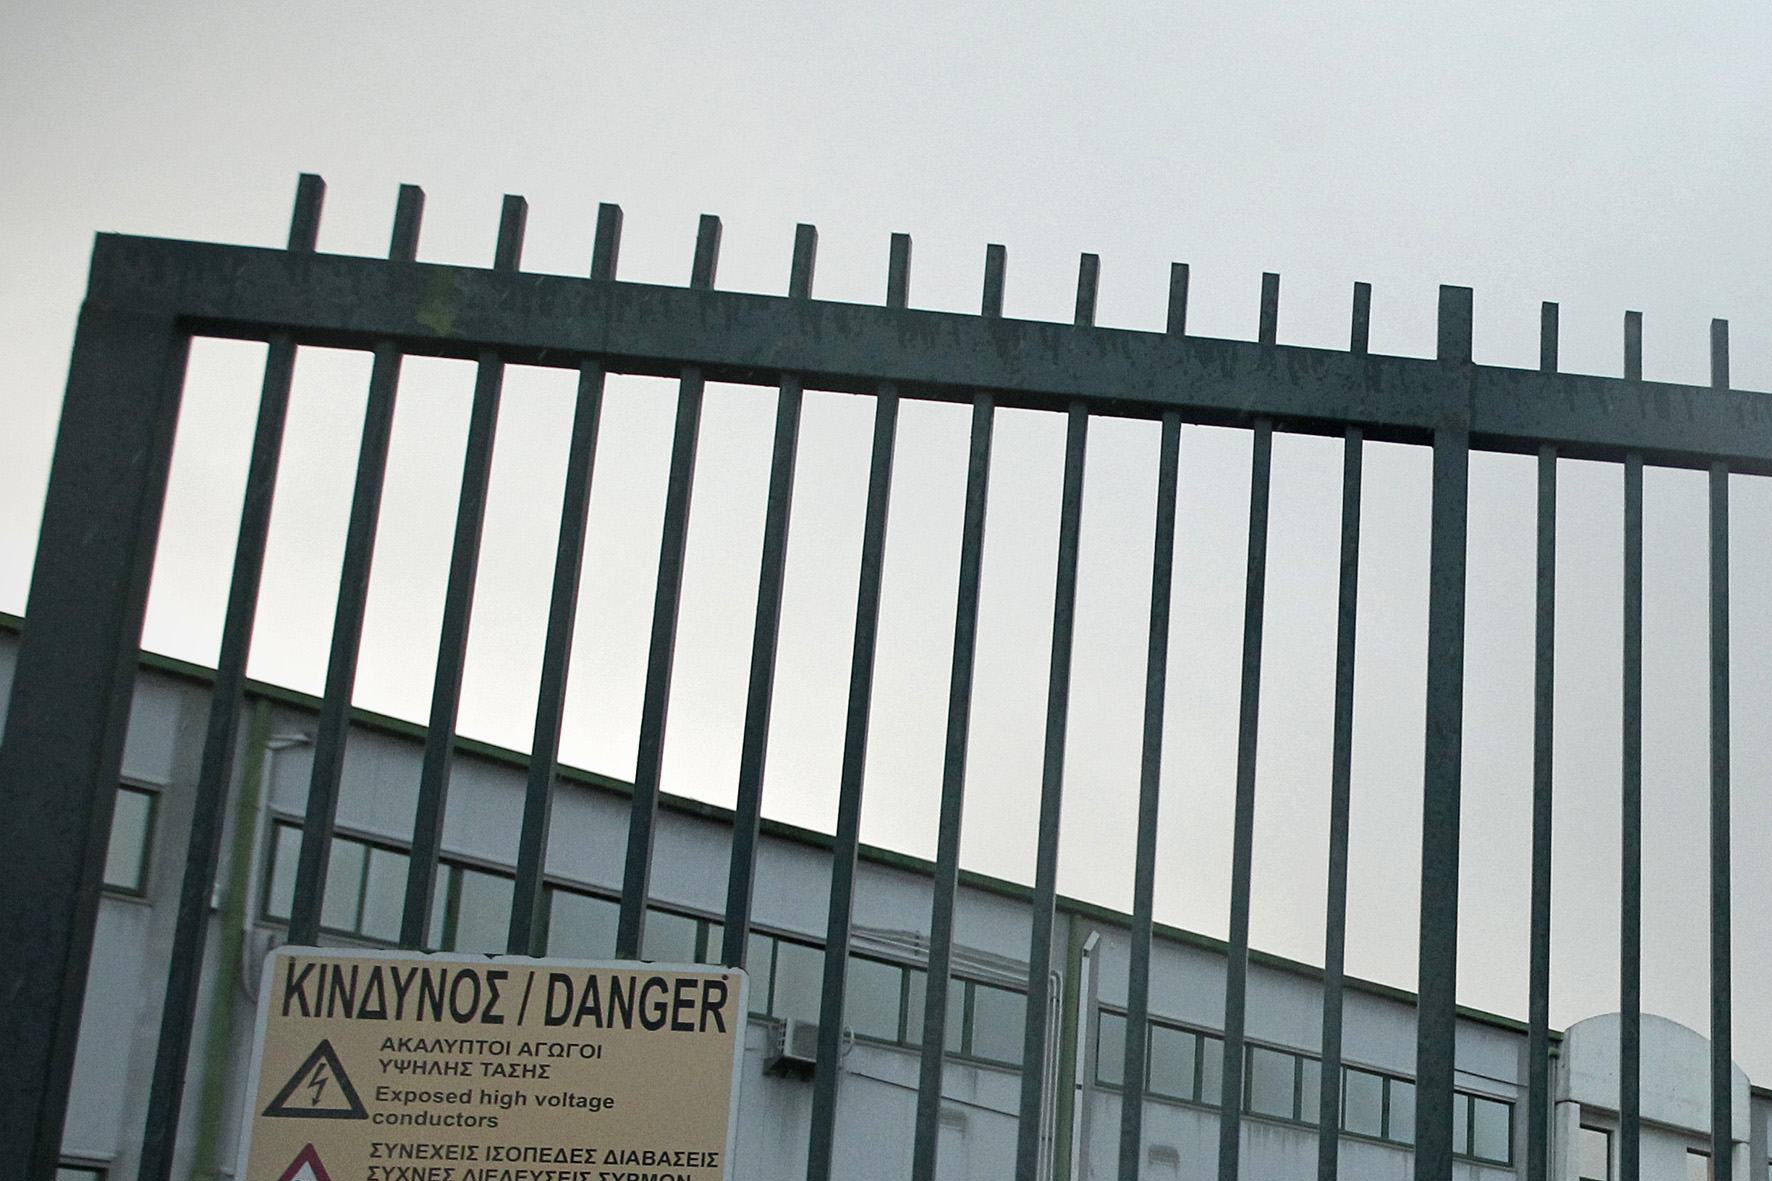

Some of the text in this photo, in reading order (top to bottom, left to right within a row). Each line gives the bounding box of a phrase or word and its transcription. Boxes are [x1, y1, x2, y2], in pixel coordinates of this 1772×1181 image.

[281, 961, 729, 1033] ΚΙΝΔΥΝΟΣ / DANGER
[380, 1037, 602, 1059] ΑΚΑΛΥΠΤΟΙ ΑΓΩΓΟΙ
[379, 1059, 551, 1080] ΥΨΗΛΗΣ ΤΑΣΗΣ
[375, 1086, 615, 1112] Exposed high voltage
[372, 1110, 499, 1129] conductors
[369, 1142, 719, 1168] ΣΥΝΕΧΕΙΣ ΙΣΟΠΕΔΕΣ ΔΙΑΒΑΣΕΙΣ
